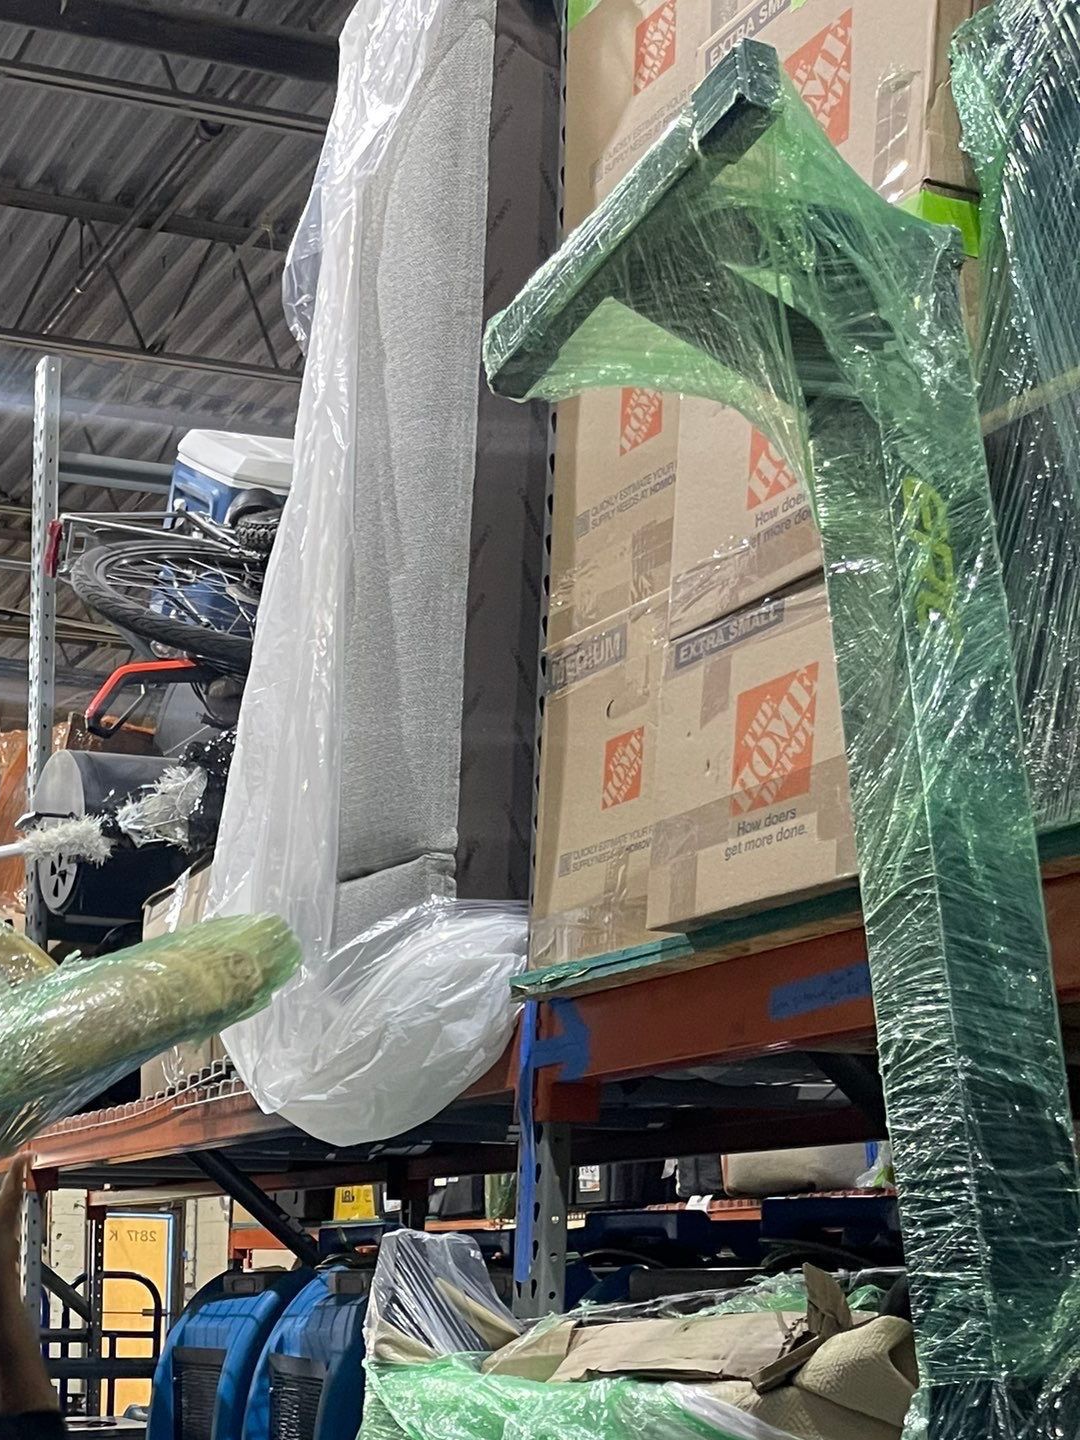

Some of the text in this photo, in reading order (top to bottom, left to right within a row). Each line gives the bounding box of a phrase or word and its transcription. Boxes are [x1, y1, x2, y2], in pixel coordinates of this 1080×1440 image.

[755, 505, 780, 527] How
[763, 518, 792, 541] more
[679, 605, 778, 662] EXTRA SMALL
[732, 668, 817, 812] HOME
[736, 807, 797, 838] How doers
[724, 823, 808, 862] get more done.
